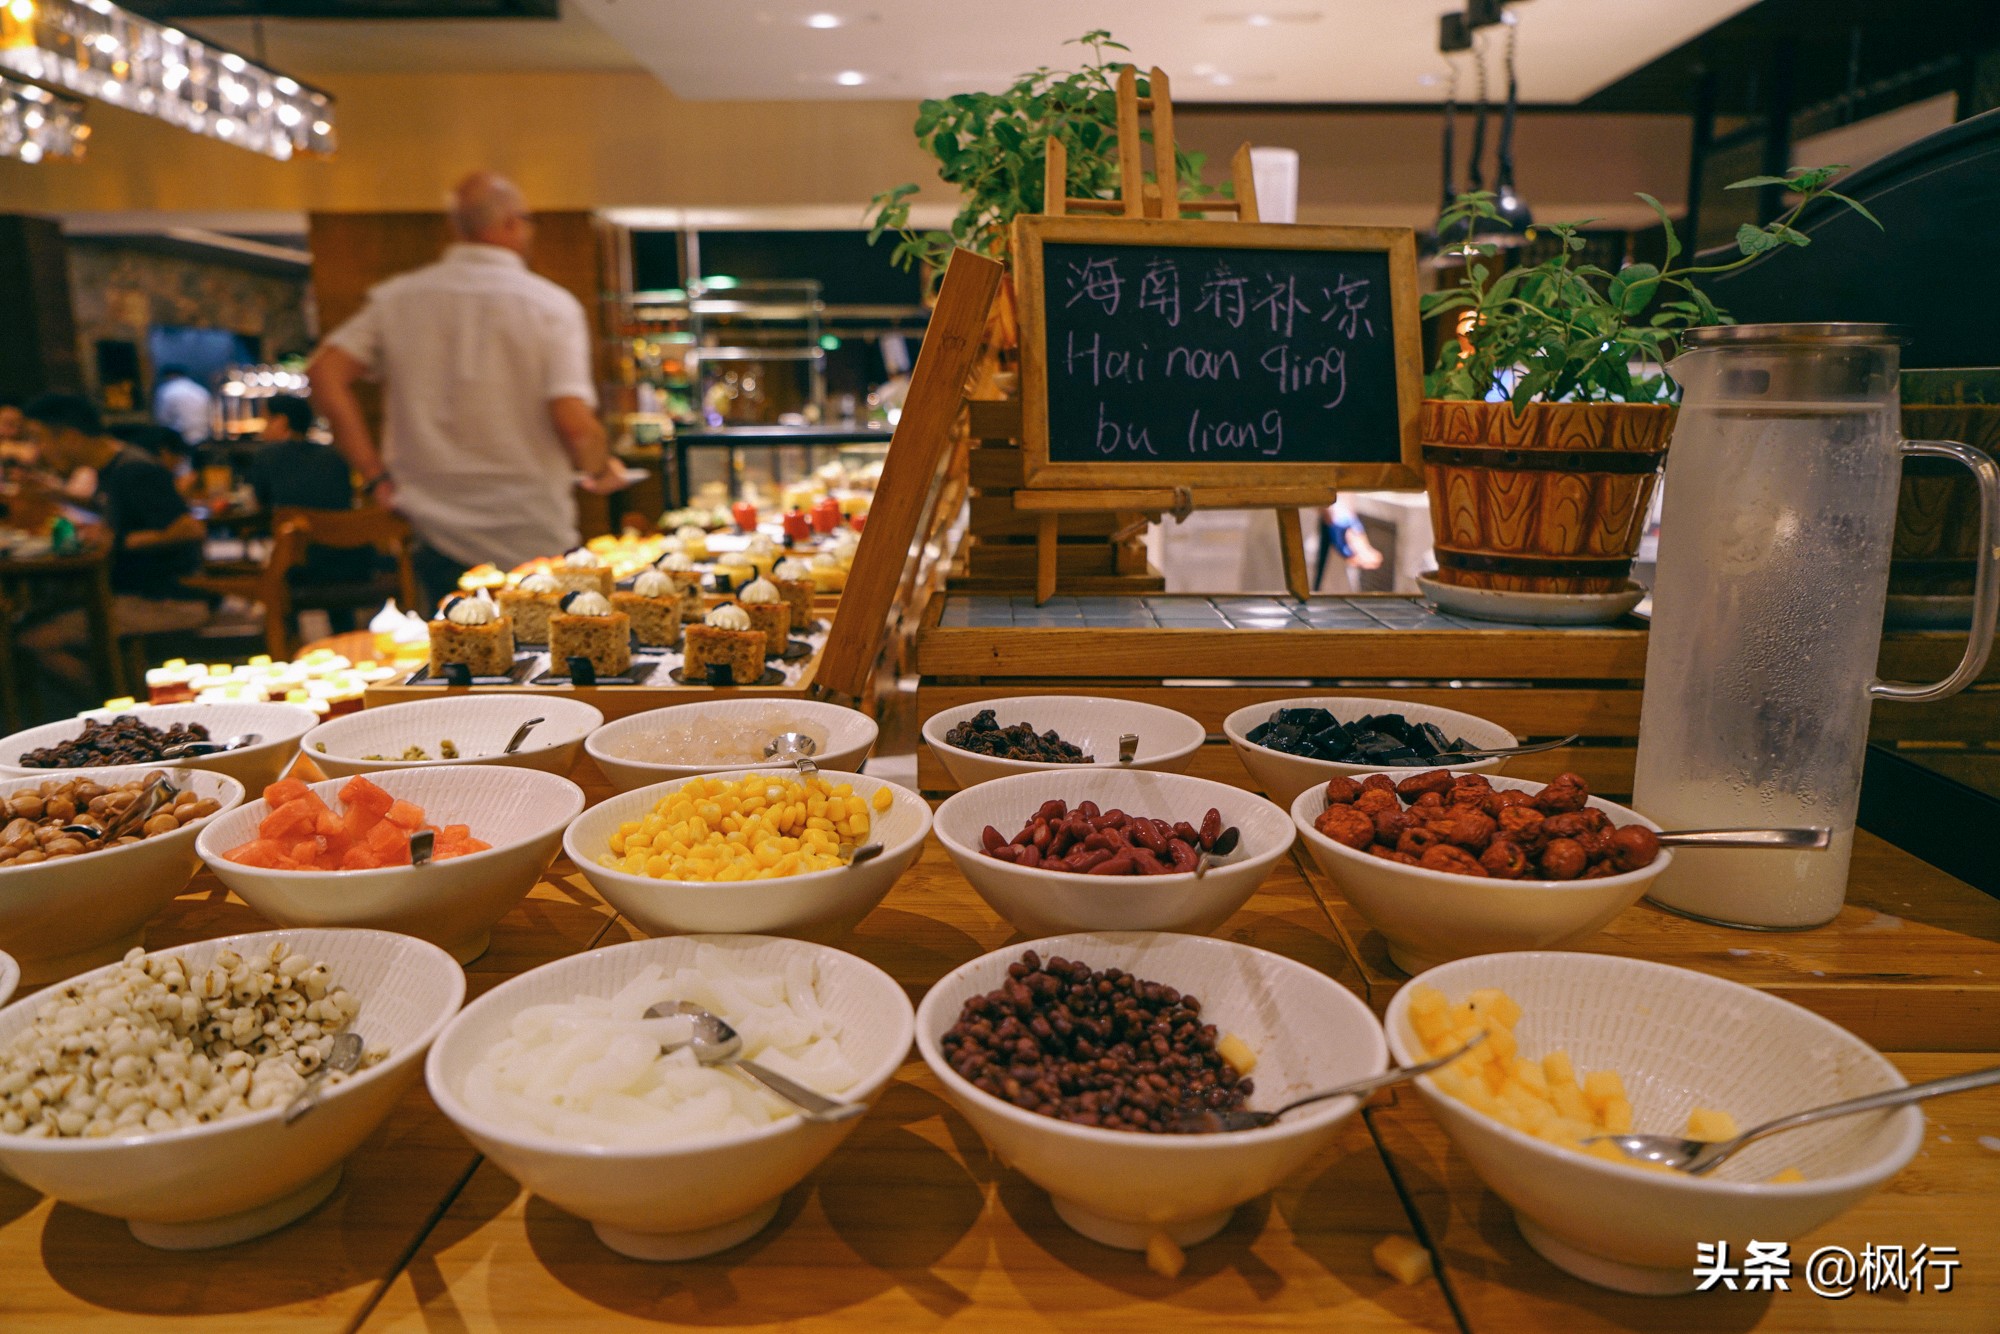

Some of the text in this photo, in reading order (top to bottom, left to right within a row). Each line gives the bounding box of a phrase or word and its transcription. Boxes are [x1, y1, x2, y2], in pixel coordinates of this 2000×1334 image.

[1064, 330, 1346, 410] Hai nan qing
[1096, 401, 1284, 456] bu liang
